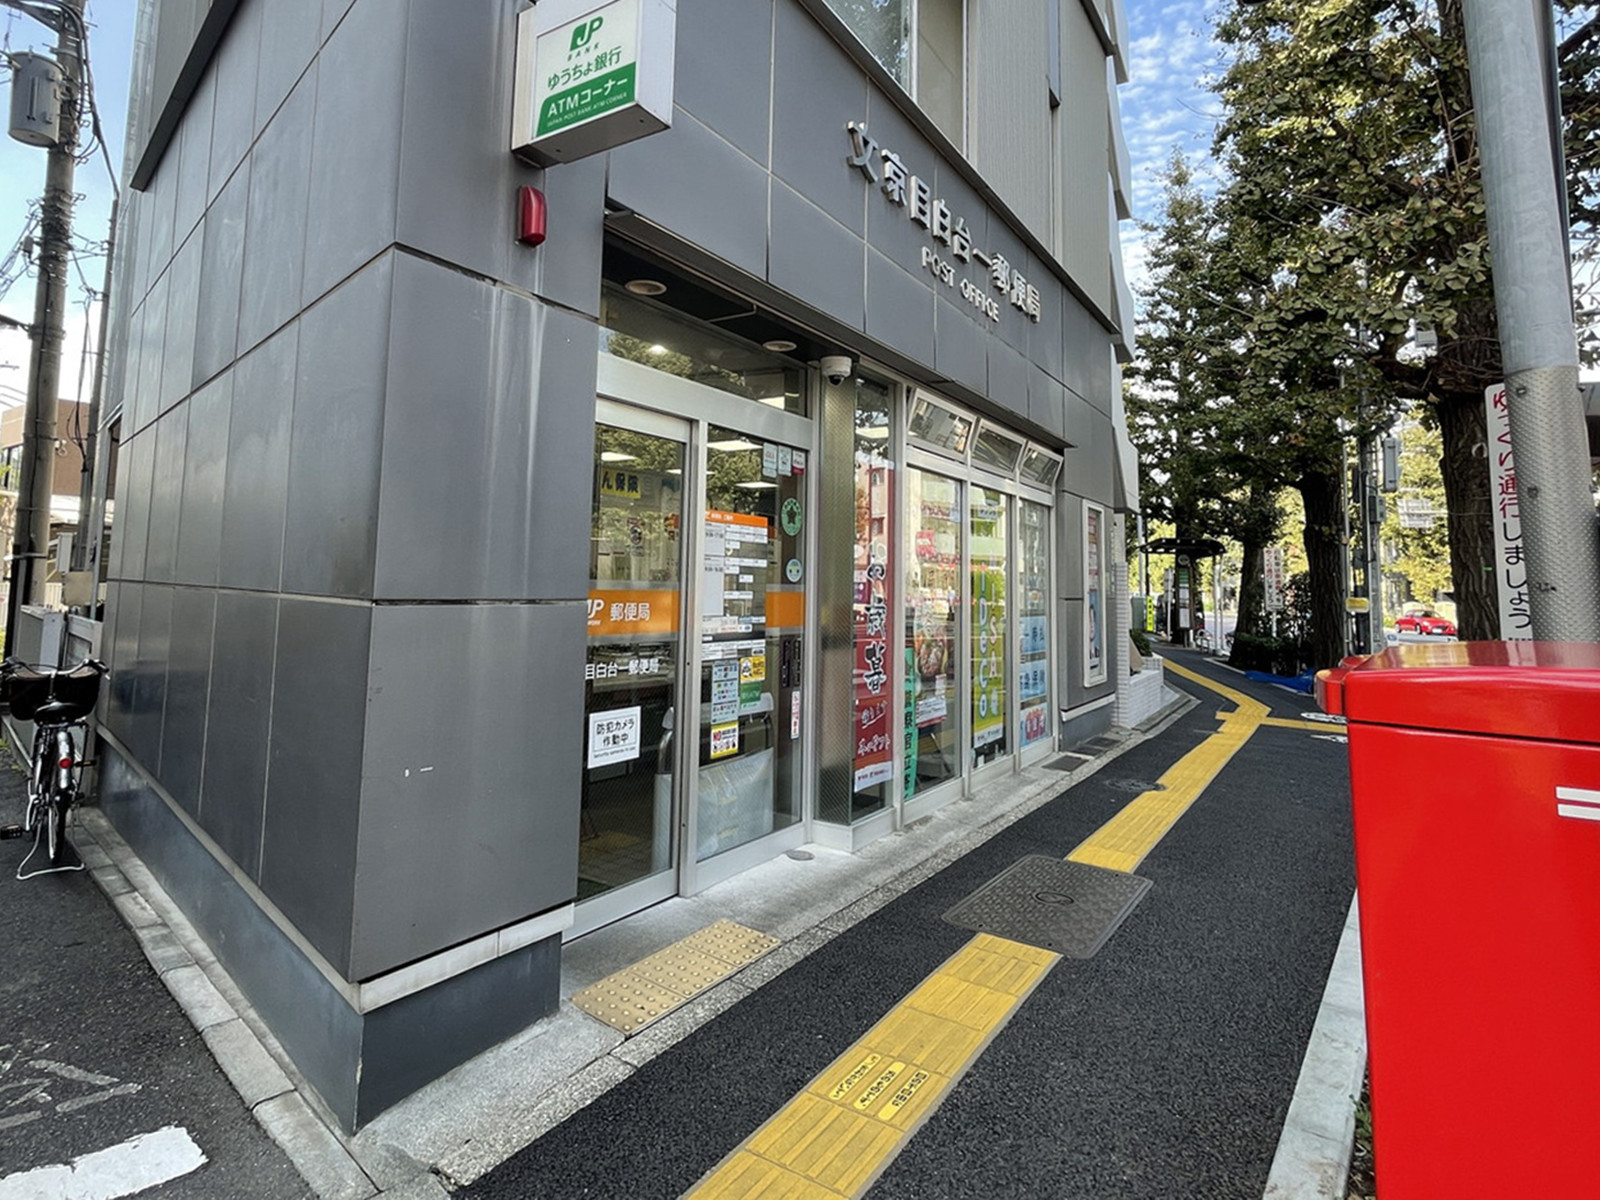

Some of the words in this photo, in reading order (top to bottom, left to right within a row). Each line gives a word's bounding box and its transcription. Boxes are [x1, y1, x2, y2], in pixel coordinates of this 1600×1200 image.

[570, 16, 604, 51] JP
[547, 45, 622, 90] ゆうちょ銀行
[547, 78, 628, 118] ATMコーナー
[845, 120, 1040, 324] 文京目白台一郵便局
[921, 246, 955, 288] POST
[960, 277, 999, 323] OFFICE
[1492, 389, 1532, 630] ゆくり通行しましょう
[610, 602, 650, 622] 郵便局
[596, 718, 635, 735] 防犯カメラ
[602, 733, 629, 747] 作動中
